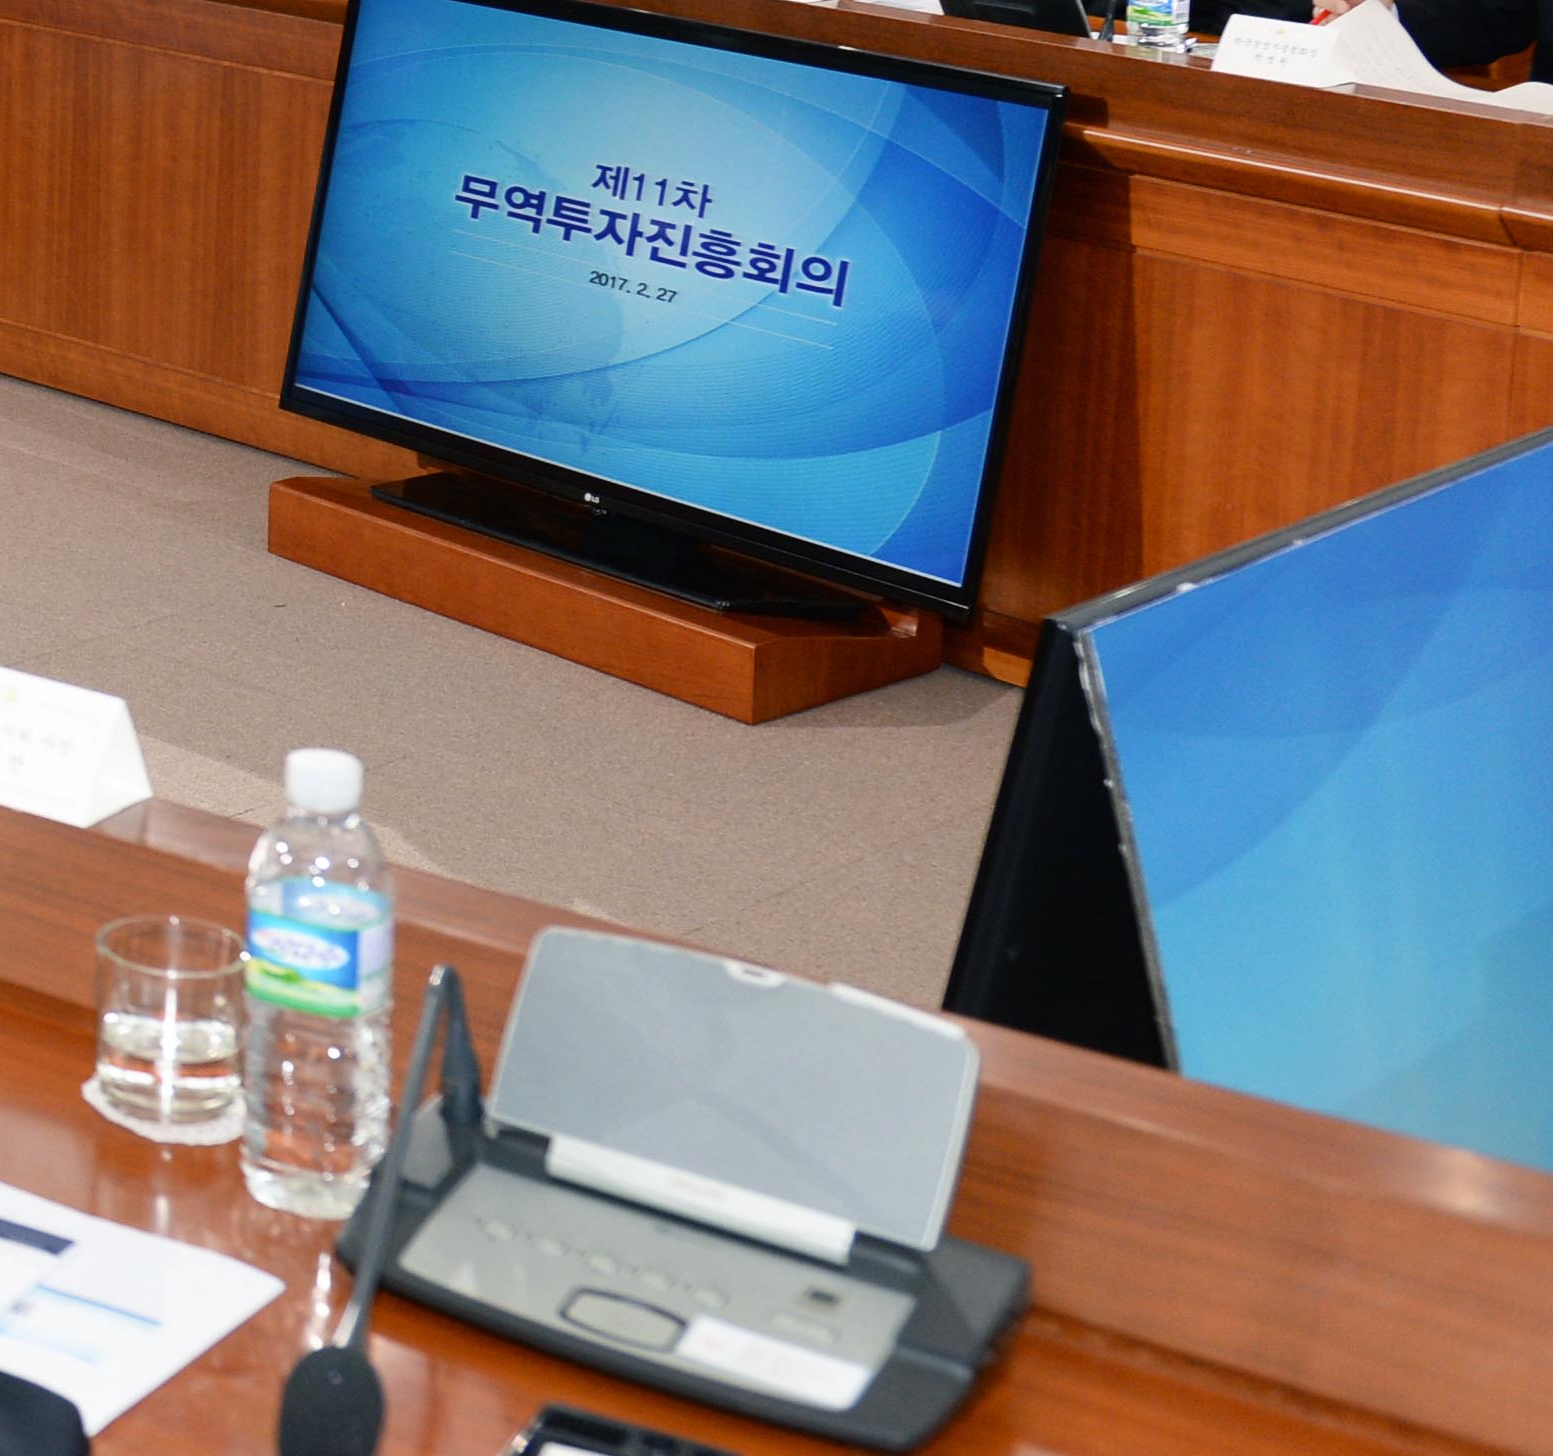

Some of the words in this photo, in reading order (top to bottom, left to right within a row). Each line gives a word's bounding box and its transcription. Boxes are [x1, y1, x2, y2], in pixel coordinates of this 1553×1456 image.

[591, 162, 714, 219] 제11차
[454, 173, 850, 308] 무역투자진흥회의
[588, 270, 631, 294] 2017.
[635, 280, 652, 299] 2.
[655, 286, 678, 305] 27
